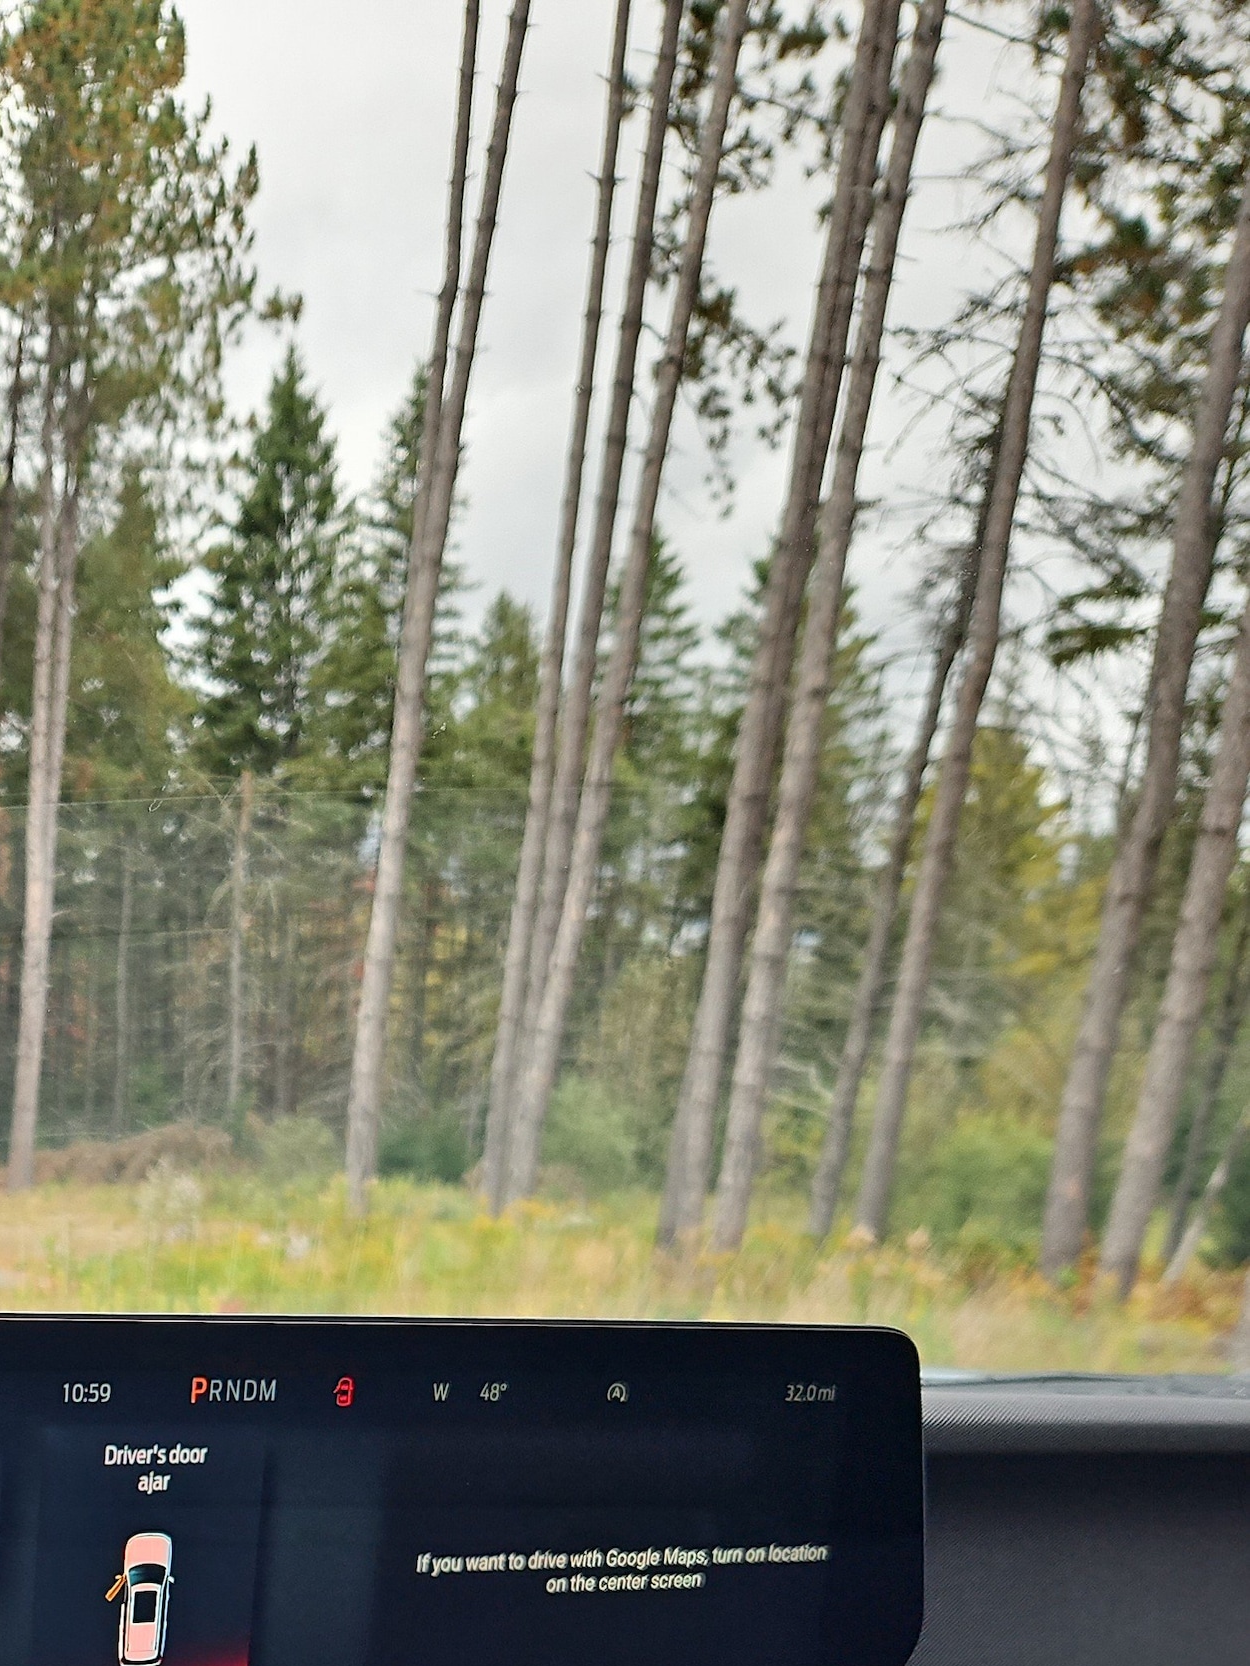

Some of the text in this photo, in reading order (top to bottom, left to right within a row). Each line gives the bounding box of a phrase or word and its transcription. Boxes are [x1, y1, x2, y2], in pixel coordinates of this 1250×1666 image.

[62, 1383, 112, 1403] 10:59
[433, 1382, 450, 1402] W
[479, 1382, 508, 1402] 48°
[104, 1443, 208, 1466] Driver's door
[137, 1471, 171, 1494] ajar
[416, 1543, 829, 1577] If you want to drive with Google Maps, turn on location
[546, 1572, 705, 1594] on the center screen
